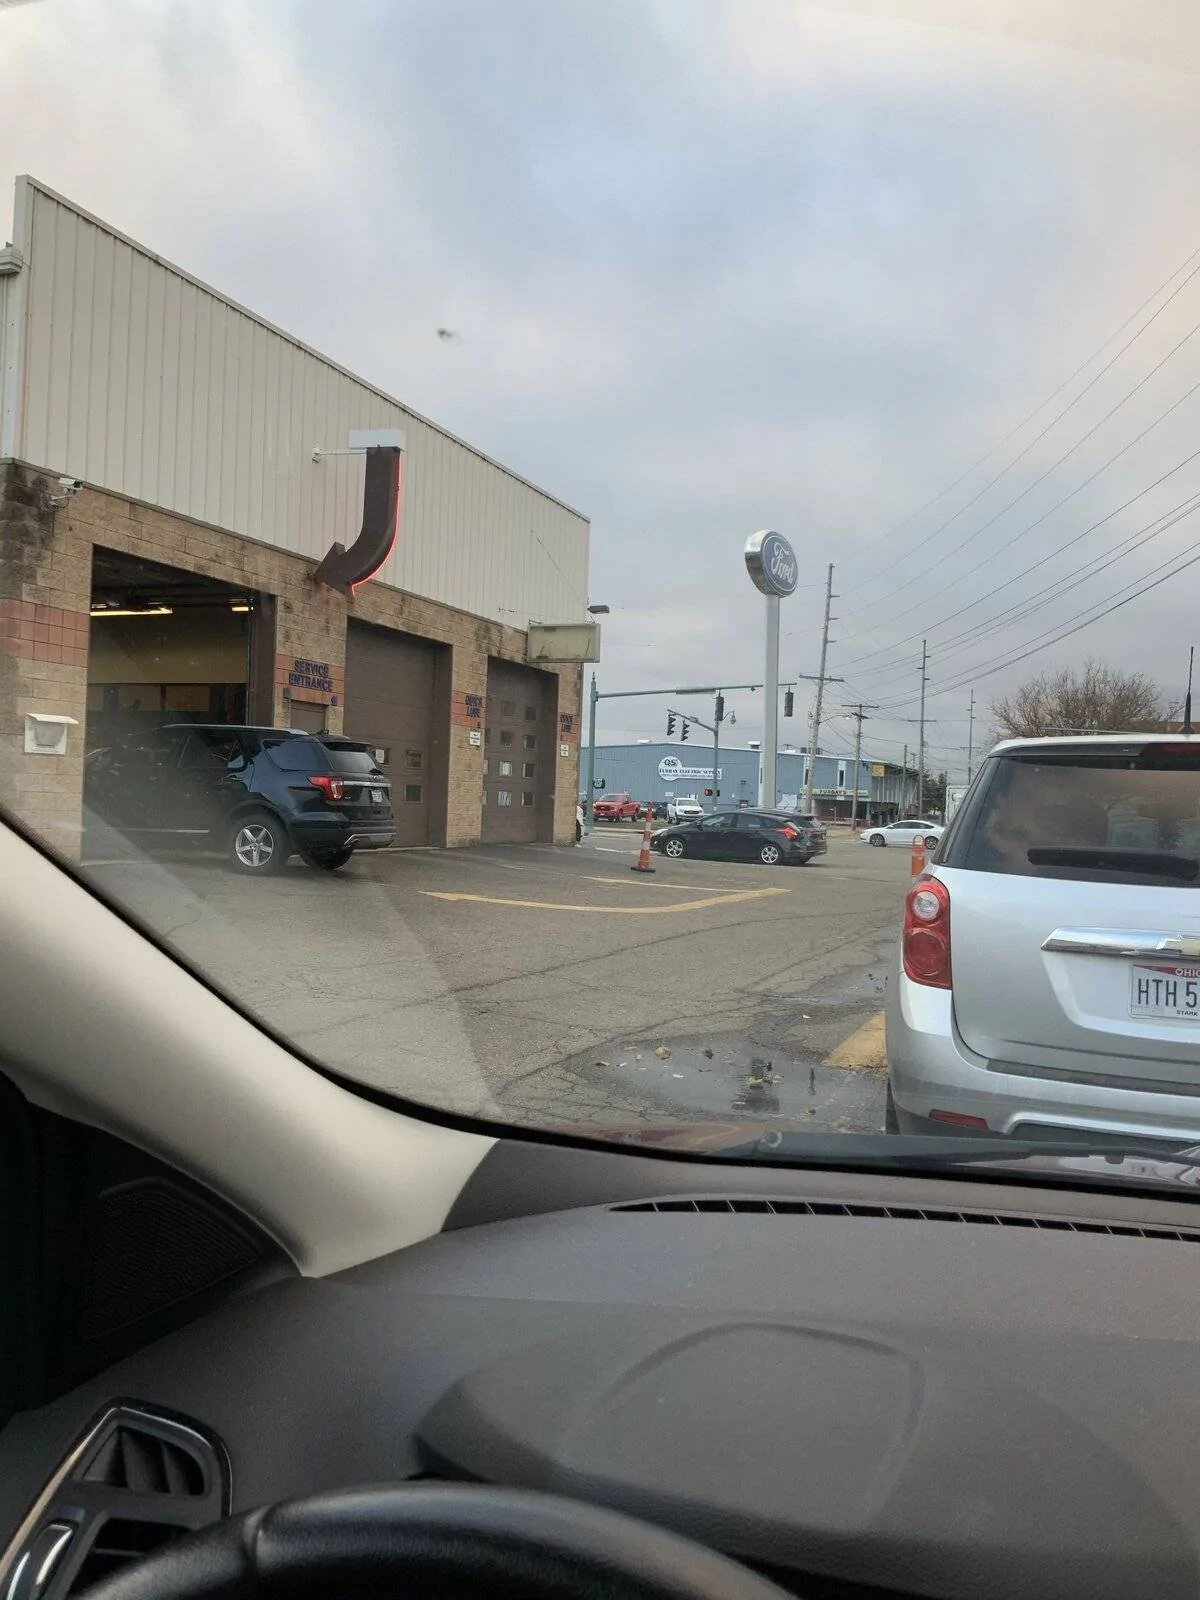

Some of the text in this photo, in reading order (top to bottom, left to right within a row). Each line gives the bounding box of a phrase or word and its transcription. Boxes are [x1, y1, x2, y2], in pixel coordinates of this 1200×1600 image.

[771, 542, 794, 584] Ford
[294, 660, 329, 678] SERVICE
[289, 673, 333, 692] ENTRANCE
[1138, 978, 1198, 1008] HTH 5
